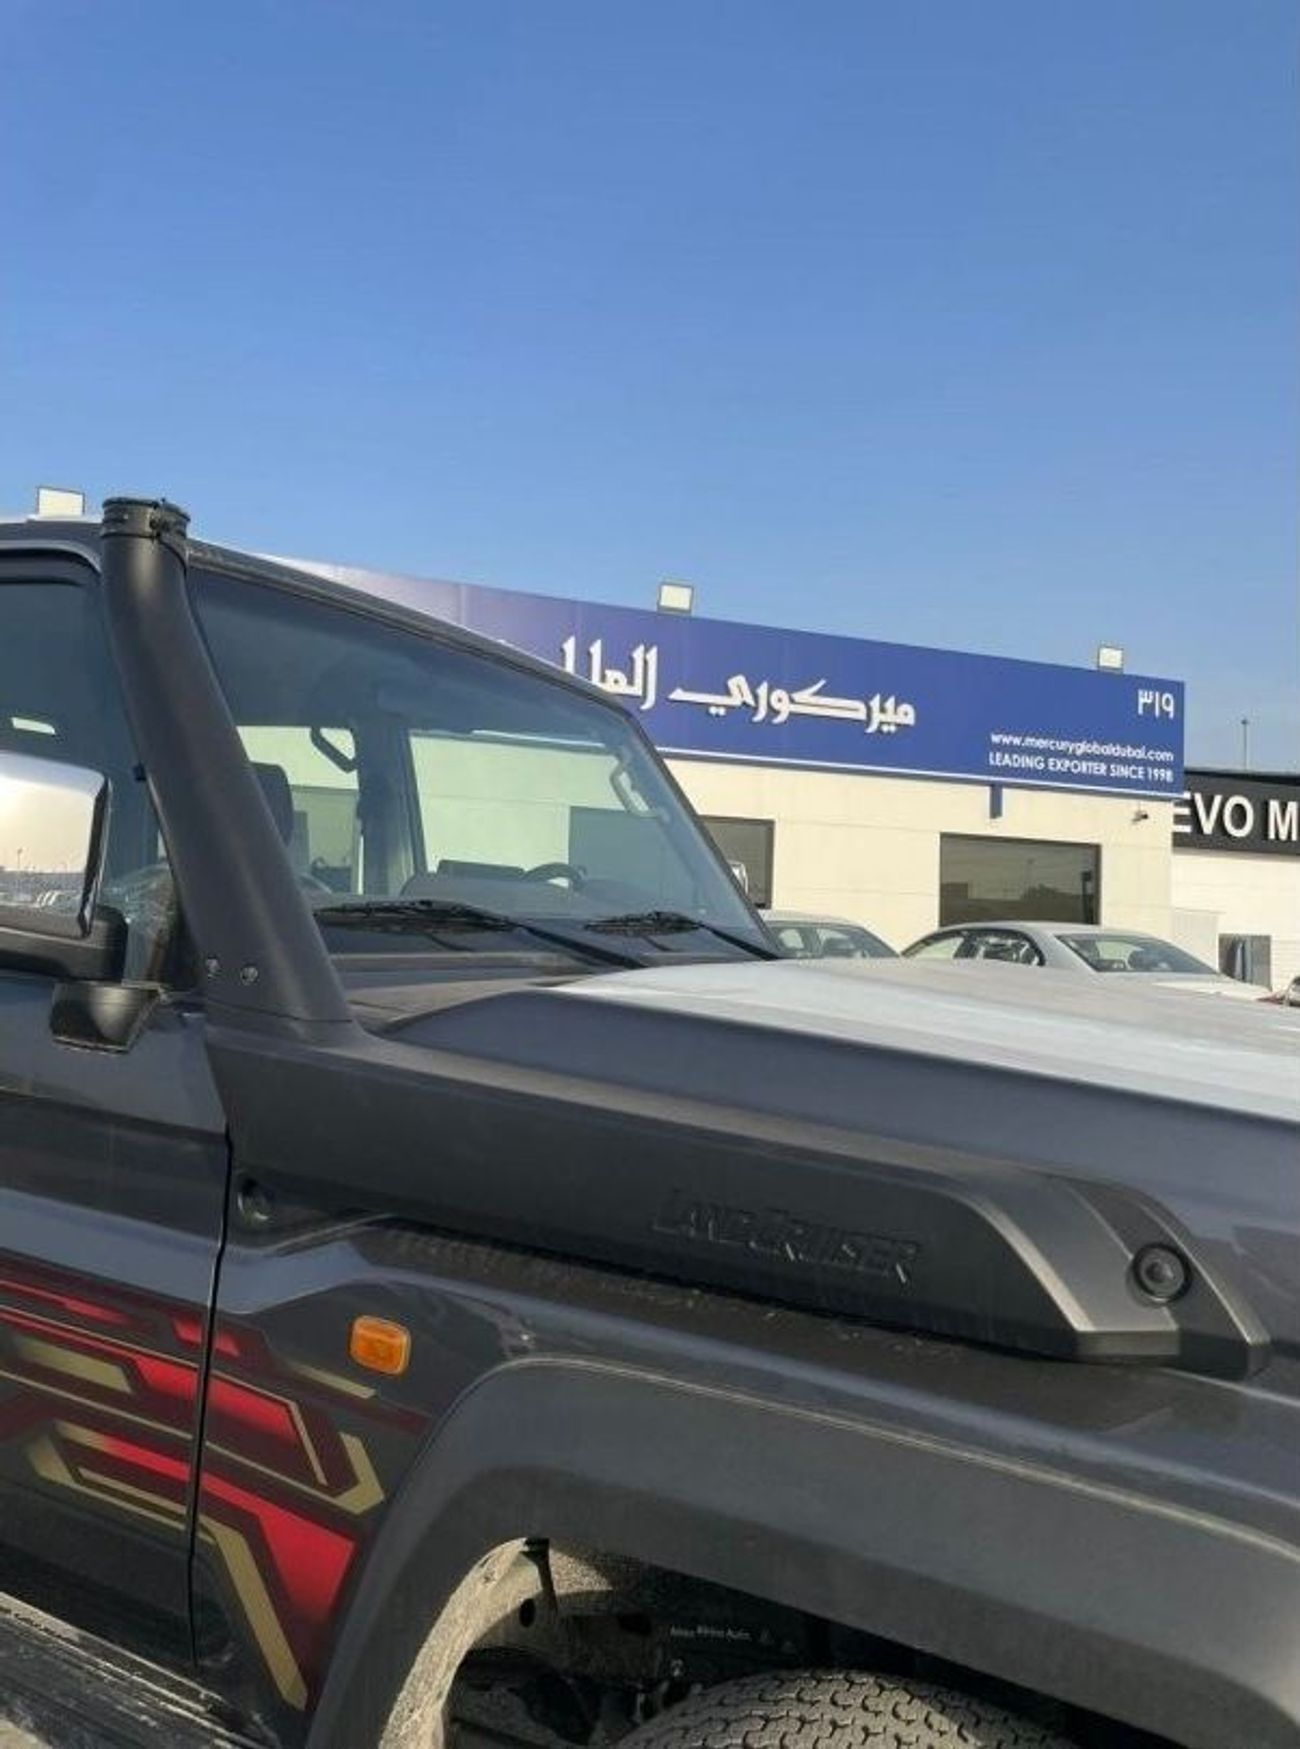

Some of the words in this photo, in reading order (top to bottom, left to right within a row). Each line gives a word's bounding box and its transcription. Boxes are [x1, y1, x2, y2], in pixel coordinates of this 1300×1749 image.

[667, 673, 916, 733] ميركوري
[989, 751, 1045, 770] LEADING
[1047, 757, 1107, 776] EXPORTER
[1109, 763, 1145, 780] SINCE
[1146, 767, 1174, 783] 1998
